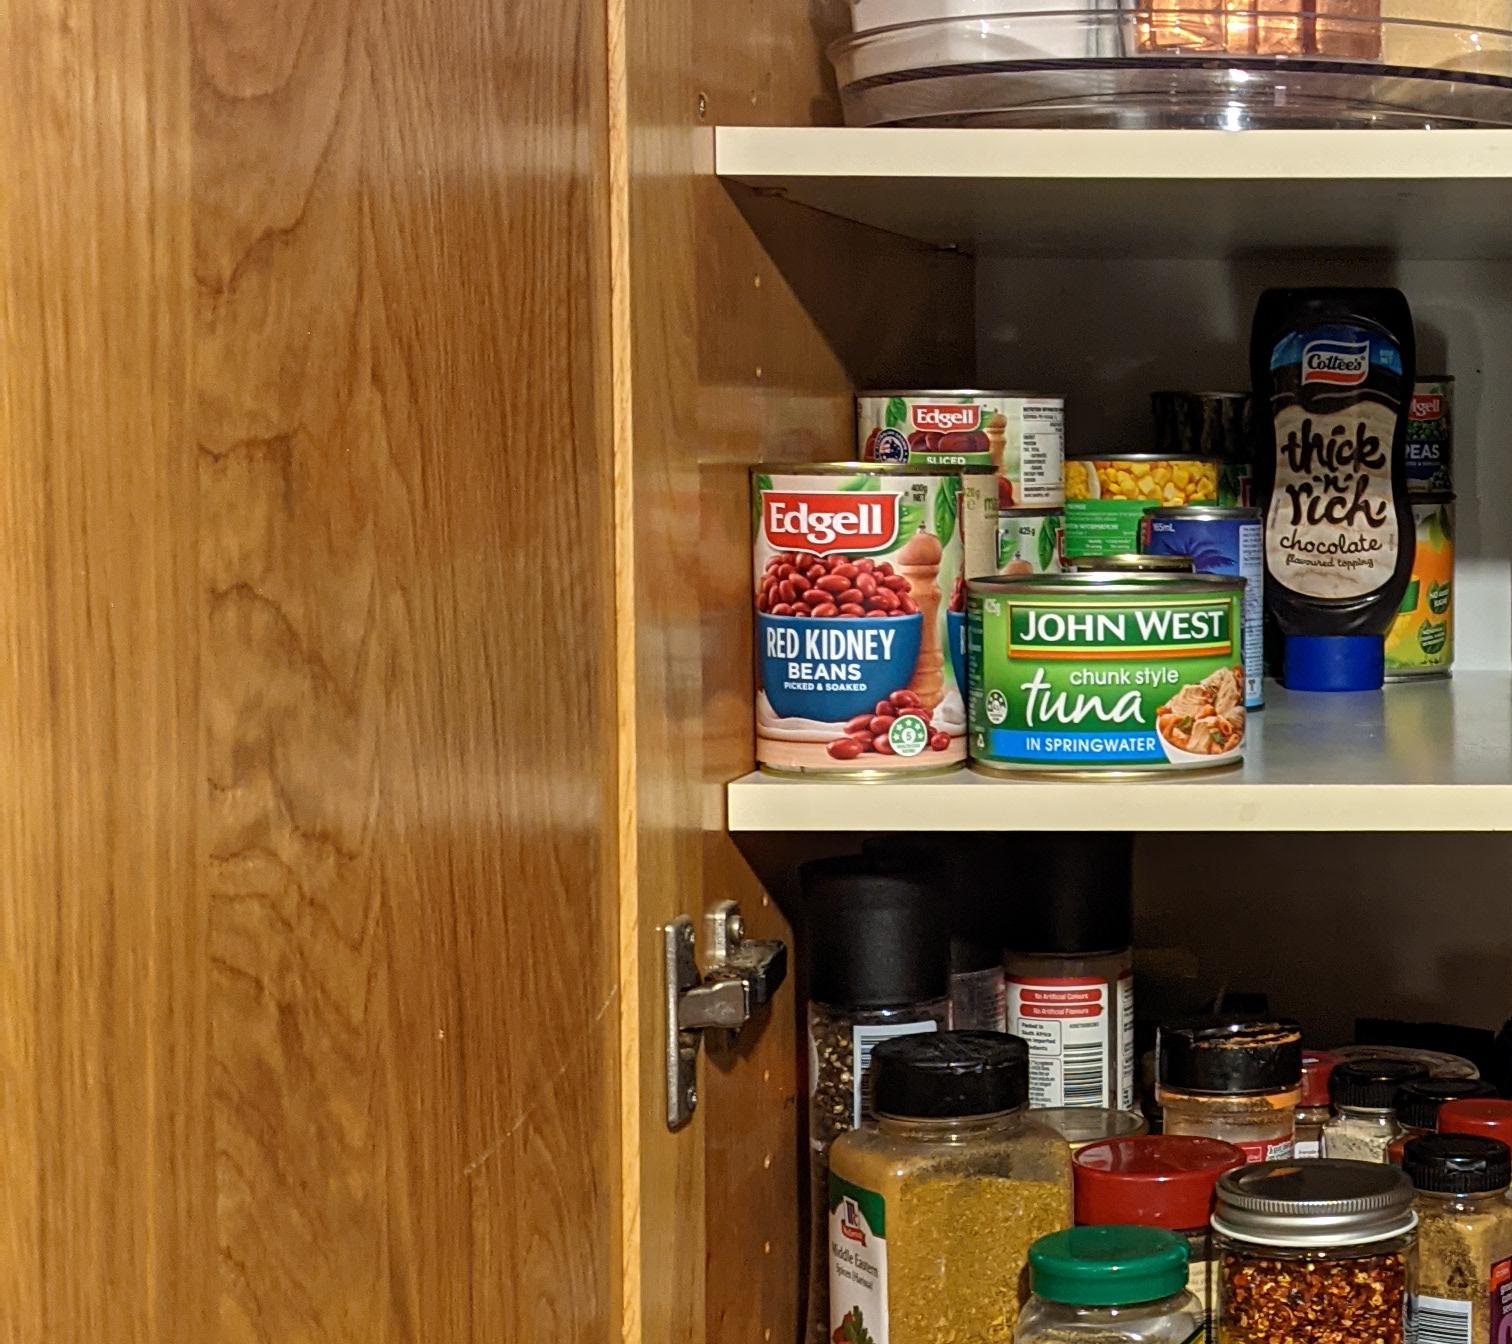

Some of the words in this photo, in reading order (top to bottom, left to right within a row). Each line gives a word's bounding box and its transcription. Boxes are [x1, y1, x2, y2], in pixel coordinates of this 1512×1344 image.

[917, 409, 973, 428] Edgell
[1281, 418, 1386, 474] thick
[912, 484, 927, 493] 400g
[1286, 474, 1387, 527] rich
[769, 502, 882, 544] Edgell
[1280, 533, 1382, 553] chocolate
[1020, 610, 1125, 642] JOHN
[1134, 610, 1224, 640] WEST
[767, 627, 799, 658] RED
[806, 629, 895, 660] KIDNEY
[788, 663, 861, 680] BEANS
[1070, 668, 1133, 685] chunk
[1136, 667, 1179, 687] style
[784, 682, 814, 690] PICKED
[817, 683, 823, 691] &
[826, 683, 867, 691] SOAKED
[1021, 668, 1146, 727] tuna
[1026, 738, 1040, 751] IN
[1045, 738, 1155, 752] SPRINGWATER
